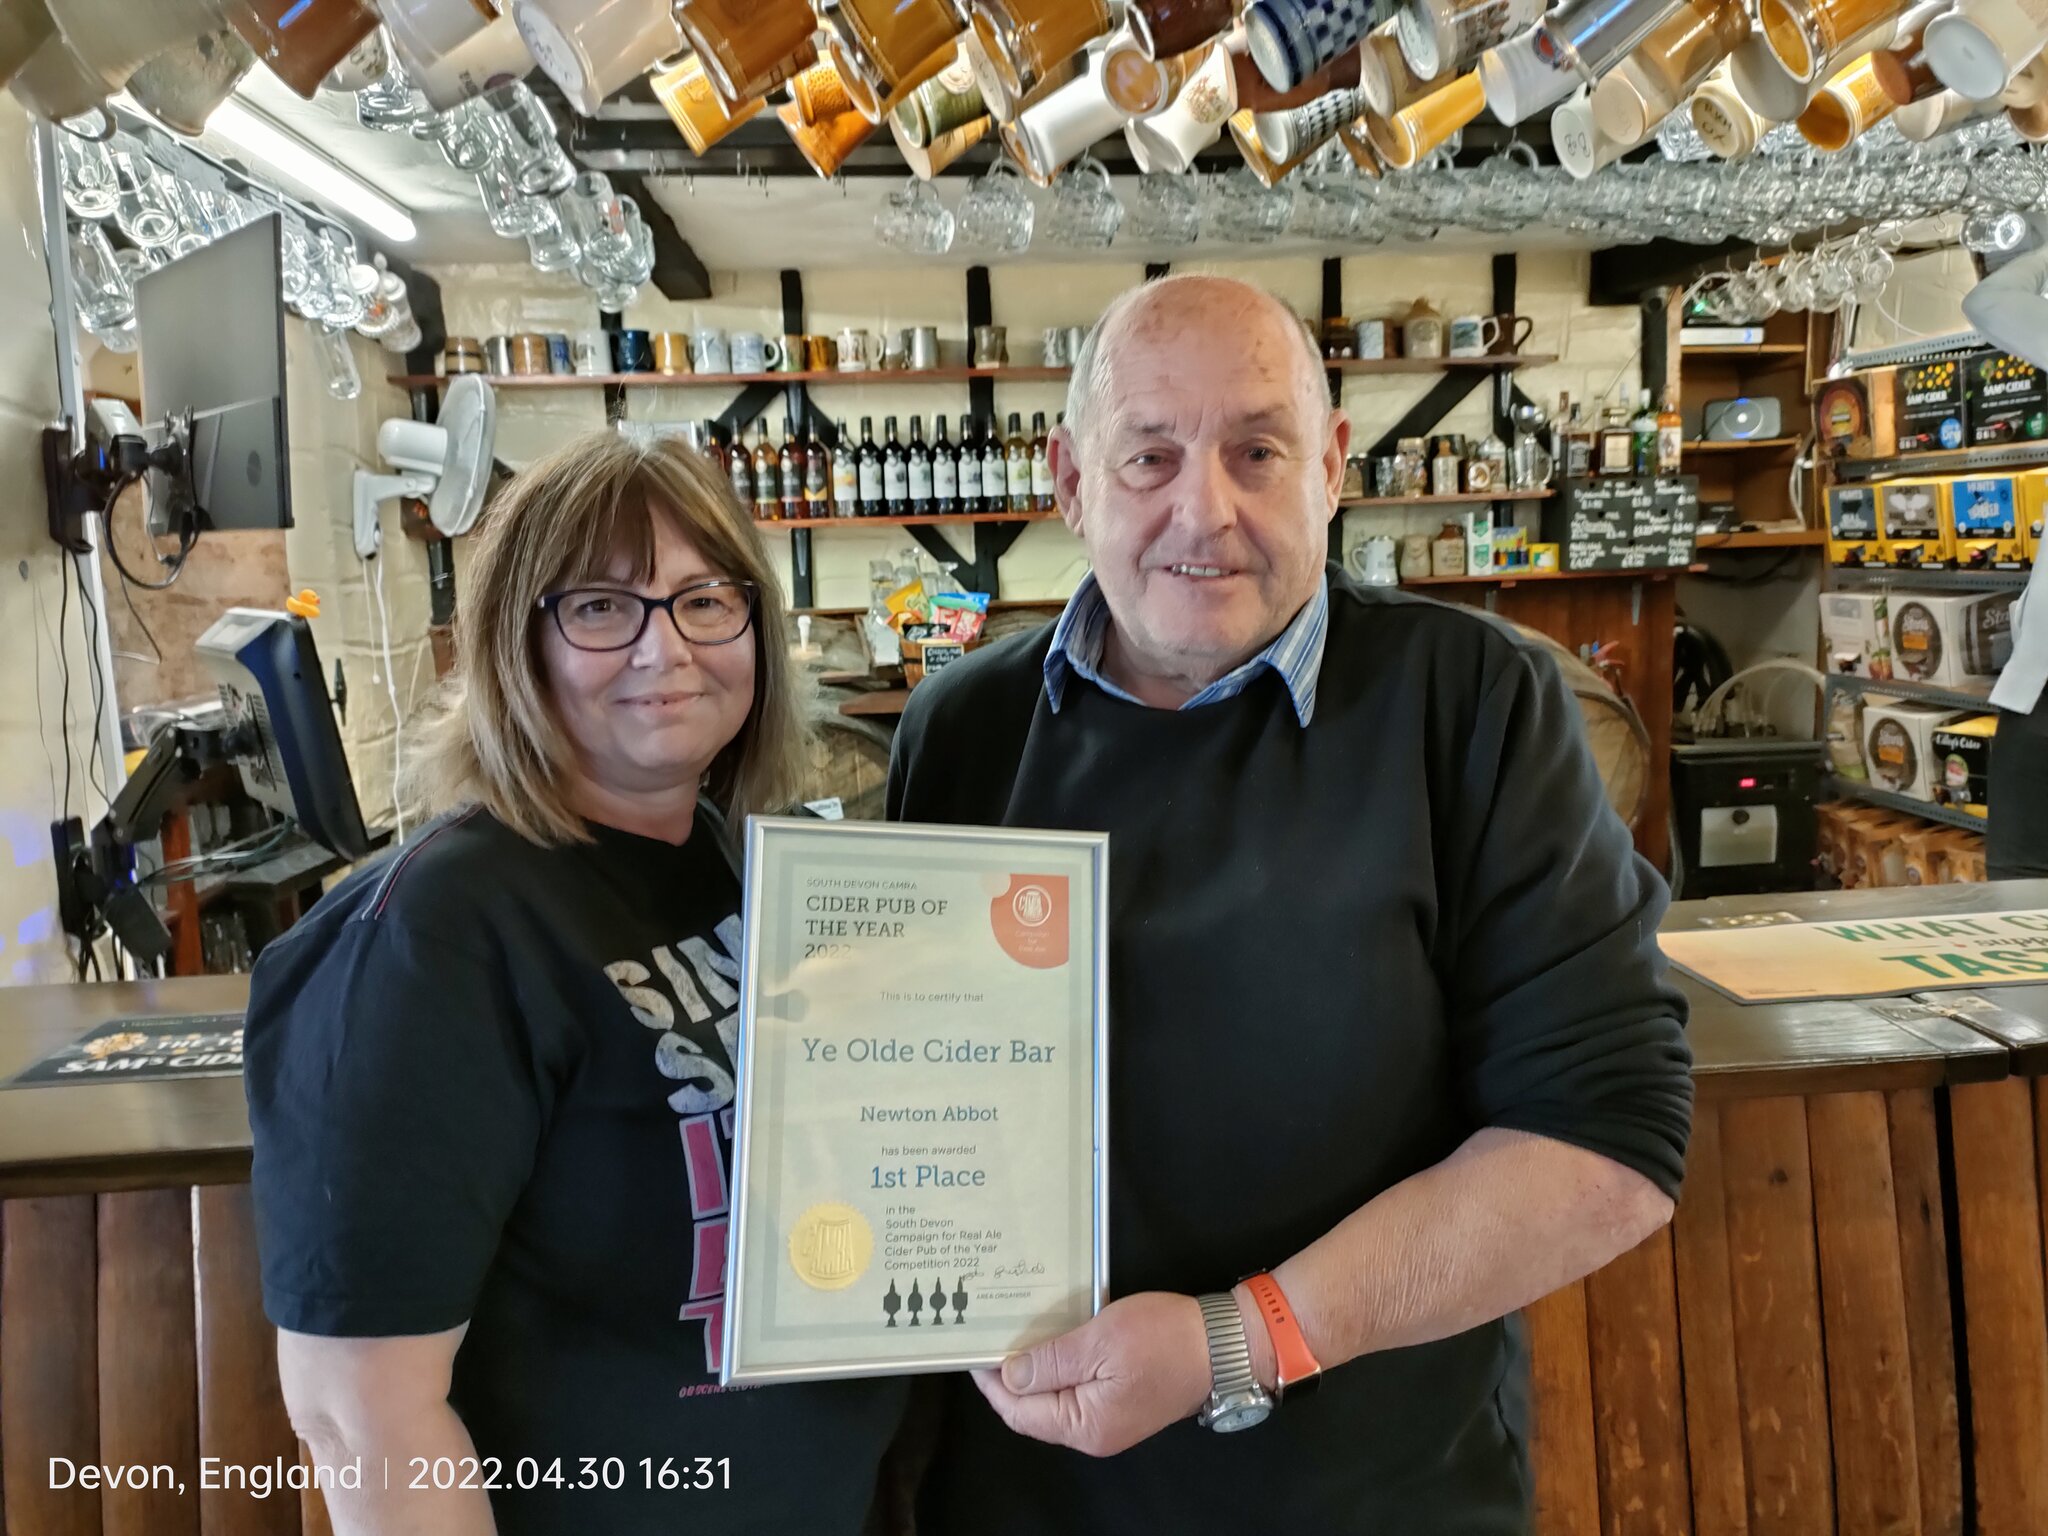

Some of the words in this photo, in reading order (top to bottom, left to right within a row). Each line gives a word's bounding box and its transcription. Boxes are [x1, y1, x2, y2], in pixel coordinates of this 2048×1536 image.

[806, 878, 841, 888] SOUTH
[843, 880, 880, 889] DEVON
[882, 881, 918, 890] CAMRA
[806, 895, 870, 913] CIDER
[875, 897, 916, 915] PUB
[921, 899, 948, 915] OF
[805, 919, 848, 936] THE
[853, 921, 905, 938] YEAR
[1812, 918, 1999, 943] WHAT
[880, 991, 901, 1001] This
[903, 992, 912, 1001] is
[915, 992, 926, 1001] to
[928, 992, 961, 1004] certify
[964, 992, 984, 1002] that
[158, 1037, 206, 1050] THE
[802, 1037, 838, 1063] Ye
[847, 1037, 914, 1063] Olde
[923, 1039, 1001, 1063] Cider
[1009, 1040, 1056, 1064] Bar
[168, 1052, 243, 1067] CID
[859, 1106, 937, 1122] Newton
[942, 1105, 999, 1122] Abbot
[881, 1145, 900, 1157] has
[902, 1145, 929, 1156] been
[932, 1144, 977, 1156] awarded
[870, 1166, 907, 1189] 1st
[914, 1165, 986, 1188] Place
[885, 1206, 895, 1215] in
[898, 1205, 916, 1215] the
[886, 1219, 917, 1230] South
[920, 1218, 954, 1229] Devon
[885, 1232, 939, 1244] Campaign
[942, 1231, 957, 1241] for
[959, 1230, 982, 1240] Real
[985, 1229, 1002, 1240] Ale
[884, 1246, 913, 1257] Cider
[916, 1245, 937, 1256] Pub
[939, 1244, 952, 1255] of
[953, 1244, 971, 1254] the
[973, 1243, 999, 1254] Year
[884, 1258, 951, 1272] Competition
[953, 1257, 980, 1268] 2022
